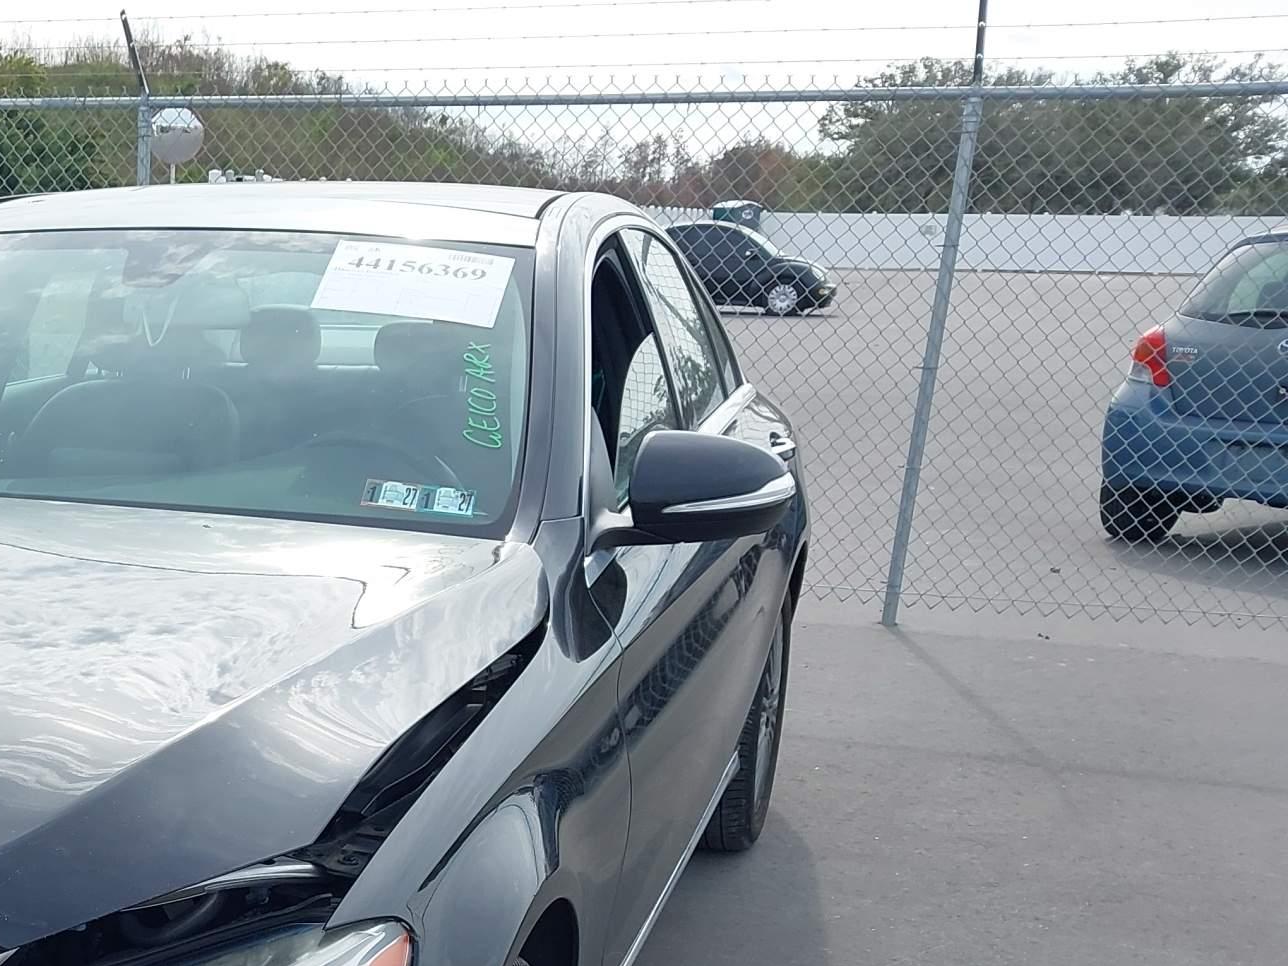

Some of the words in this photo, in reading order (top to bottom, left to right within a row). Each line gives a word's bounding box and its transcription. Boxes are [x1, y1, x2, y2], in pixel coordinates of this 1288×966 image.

[347, 255, 488, 281] 44156369
[402, 487, 418, 508] 27
[457, 493, 473, 514] 27
